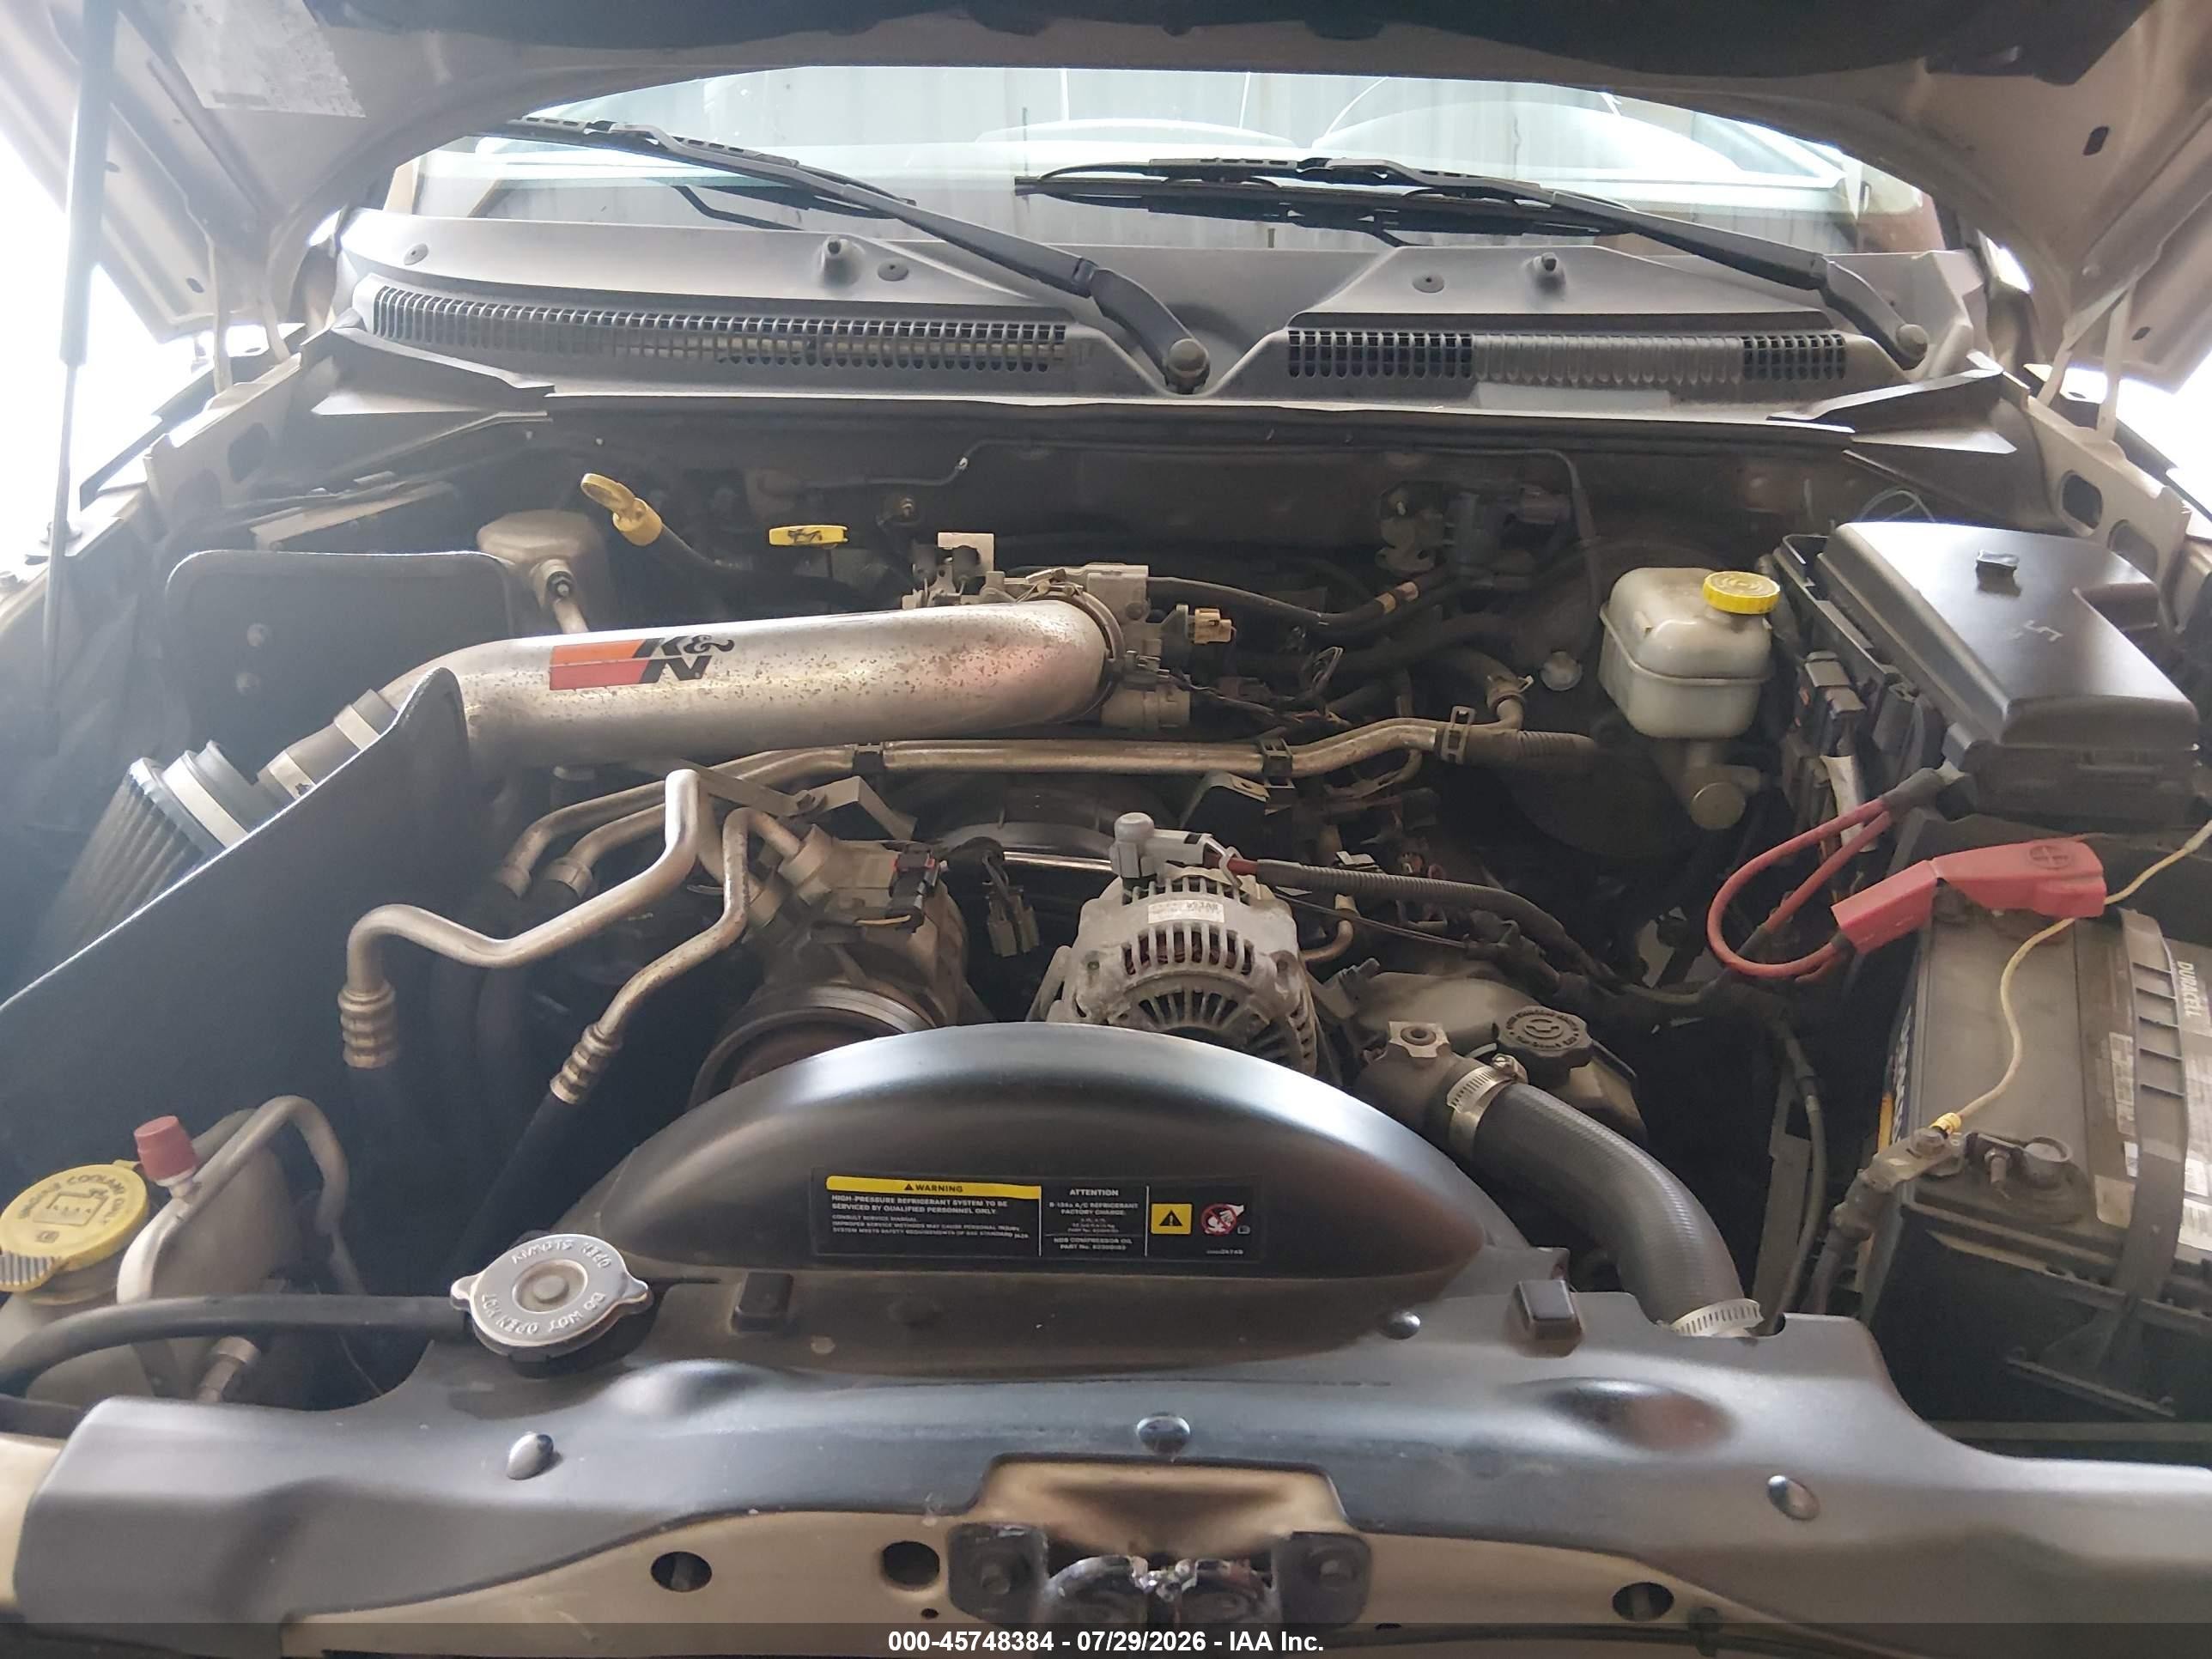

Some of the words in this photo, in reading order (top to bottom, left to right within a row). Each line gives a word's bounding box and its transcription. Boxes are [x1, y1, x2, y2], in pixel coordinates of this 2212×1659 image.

[2178, 961, 2201, 1018] DURACELL
[915, 1183, 963, 1193] WARNING
[831, 1194, 895, 1204] HIGH-PRESSURE
[897, 1197, 951, 1206] REFRIGERANT
[927, 1206, 973, 1214] PERSONNEL
[580, 1242, 612, 1268] OPEN
[481, 1292, 503, 1319] HOT
[583, 1291, 606, 1312] DO
[495, 1315, 539, 1335] OPEN
[548, 1310, 584, 1333] NOT
